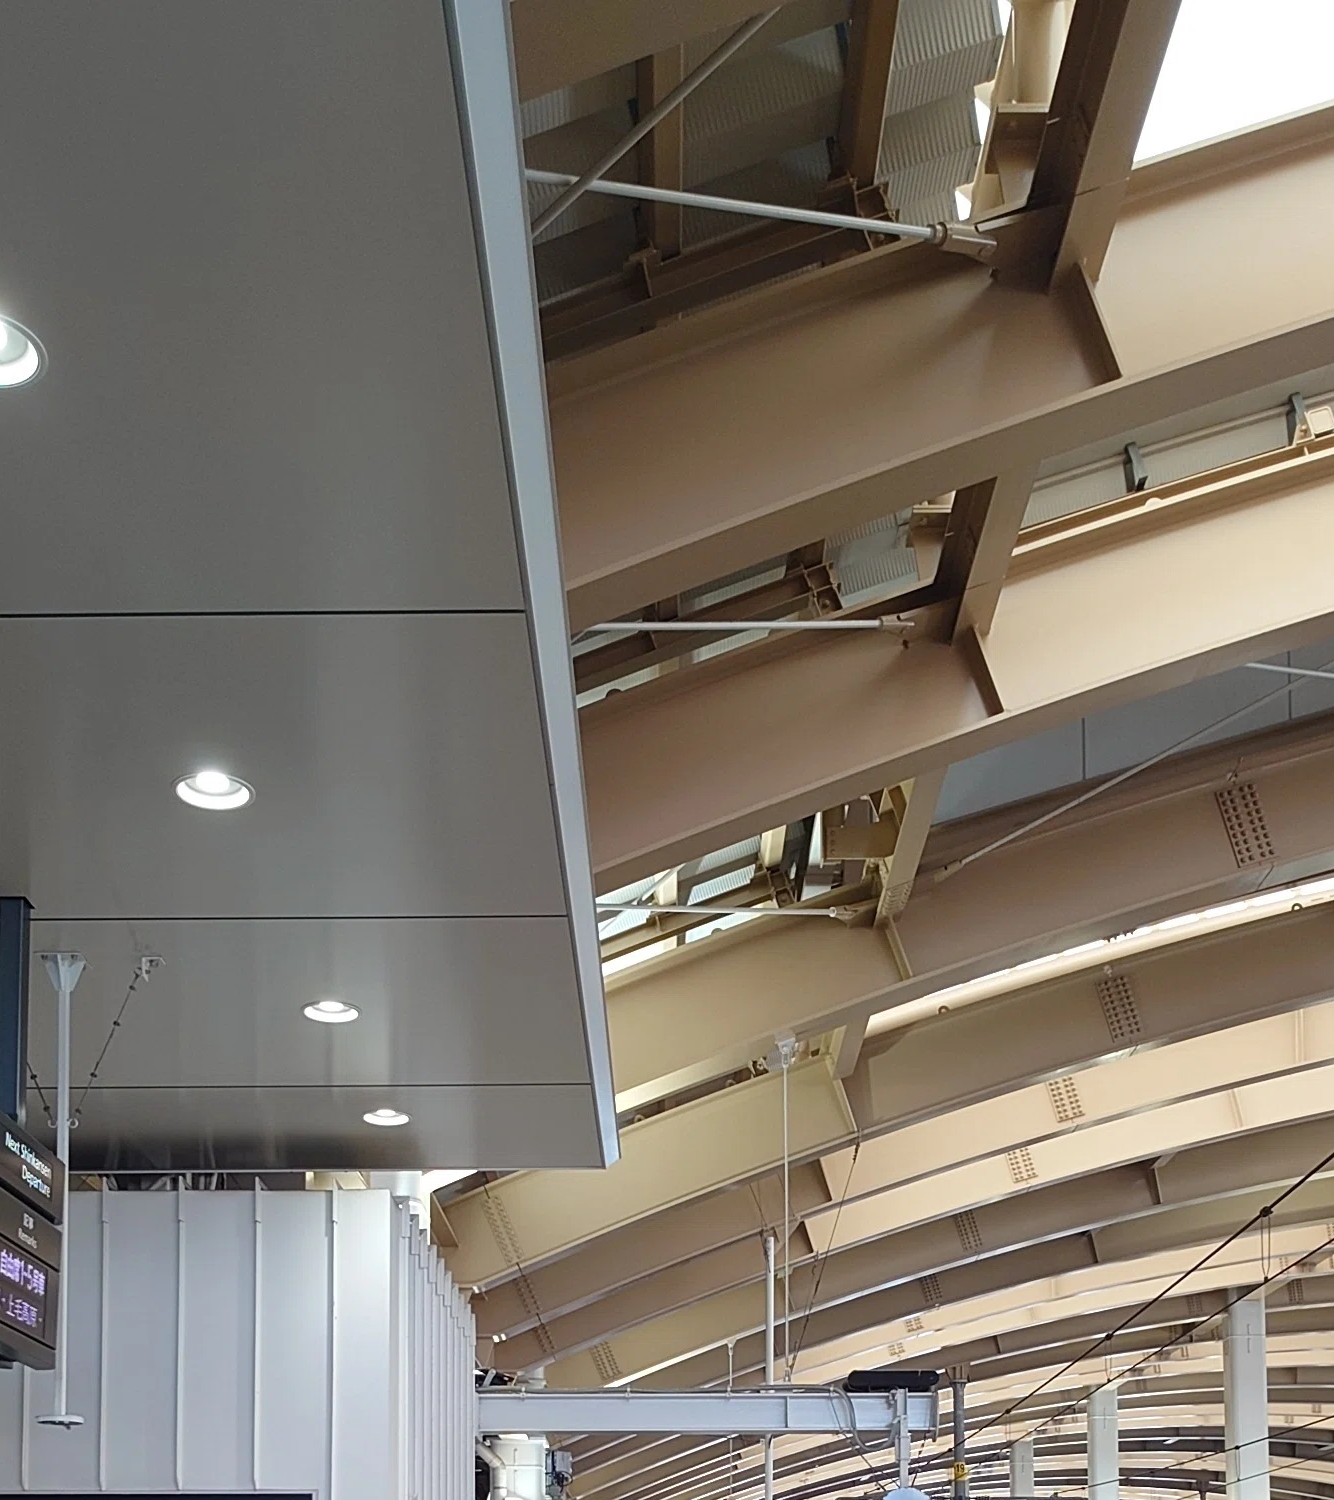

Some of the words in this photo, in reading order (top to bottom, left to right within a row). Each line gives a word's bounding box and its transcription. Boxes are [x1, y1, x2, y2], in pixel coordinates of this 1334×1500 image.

[5, 1131, 20, 1156] Next
[21, 1143, 52, 1180] Shinkansen
[22, 1164, 51, 1198] Departure
[956, 1463, 965, 1473] 19
